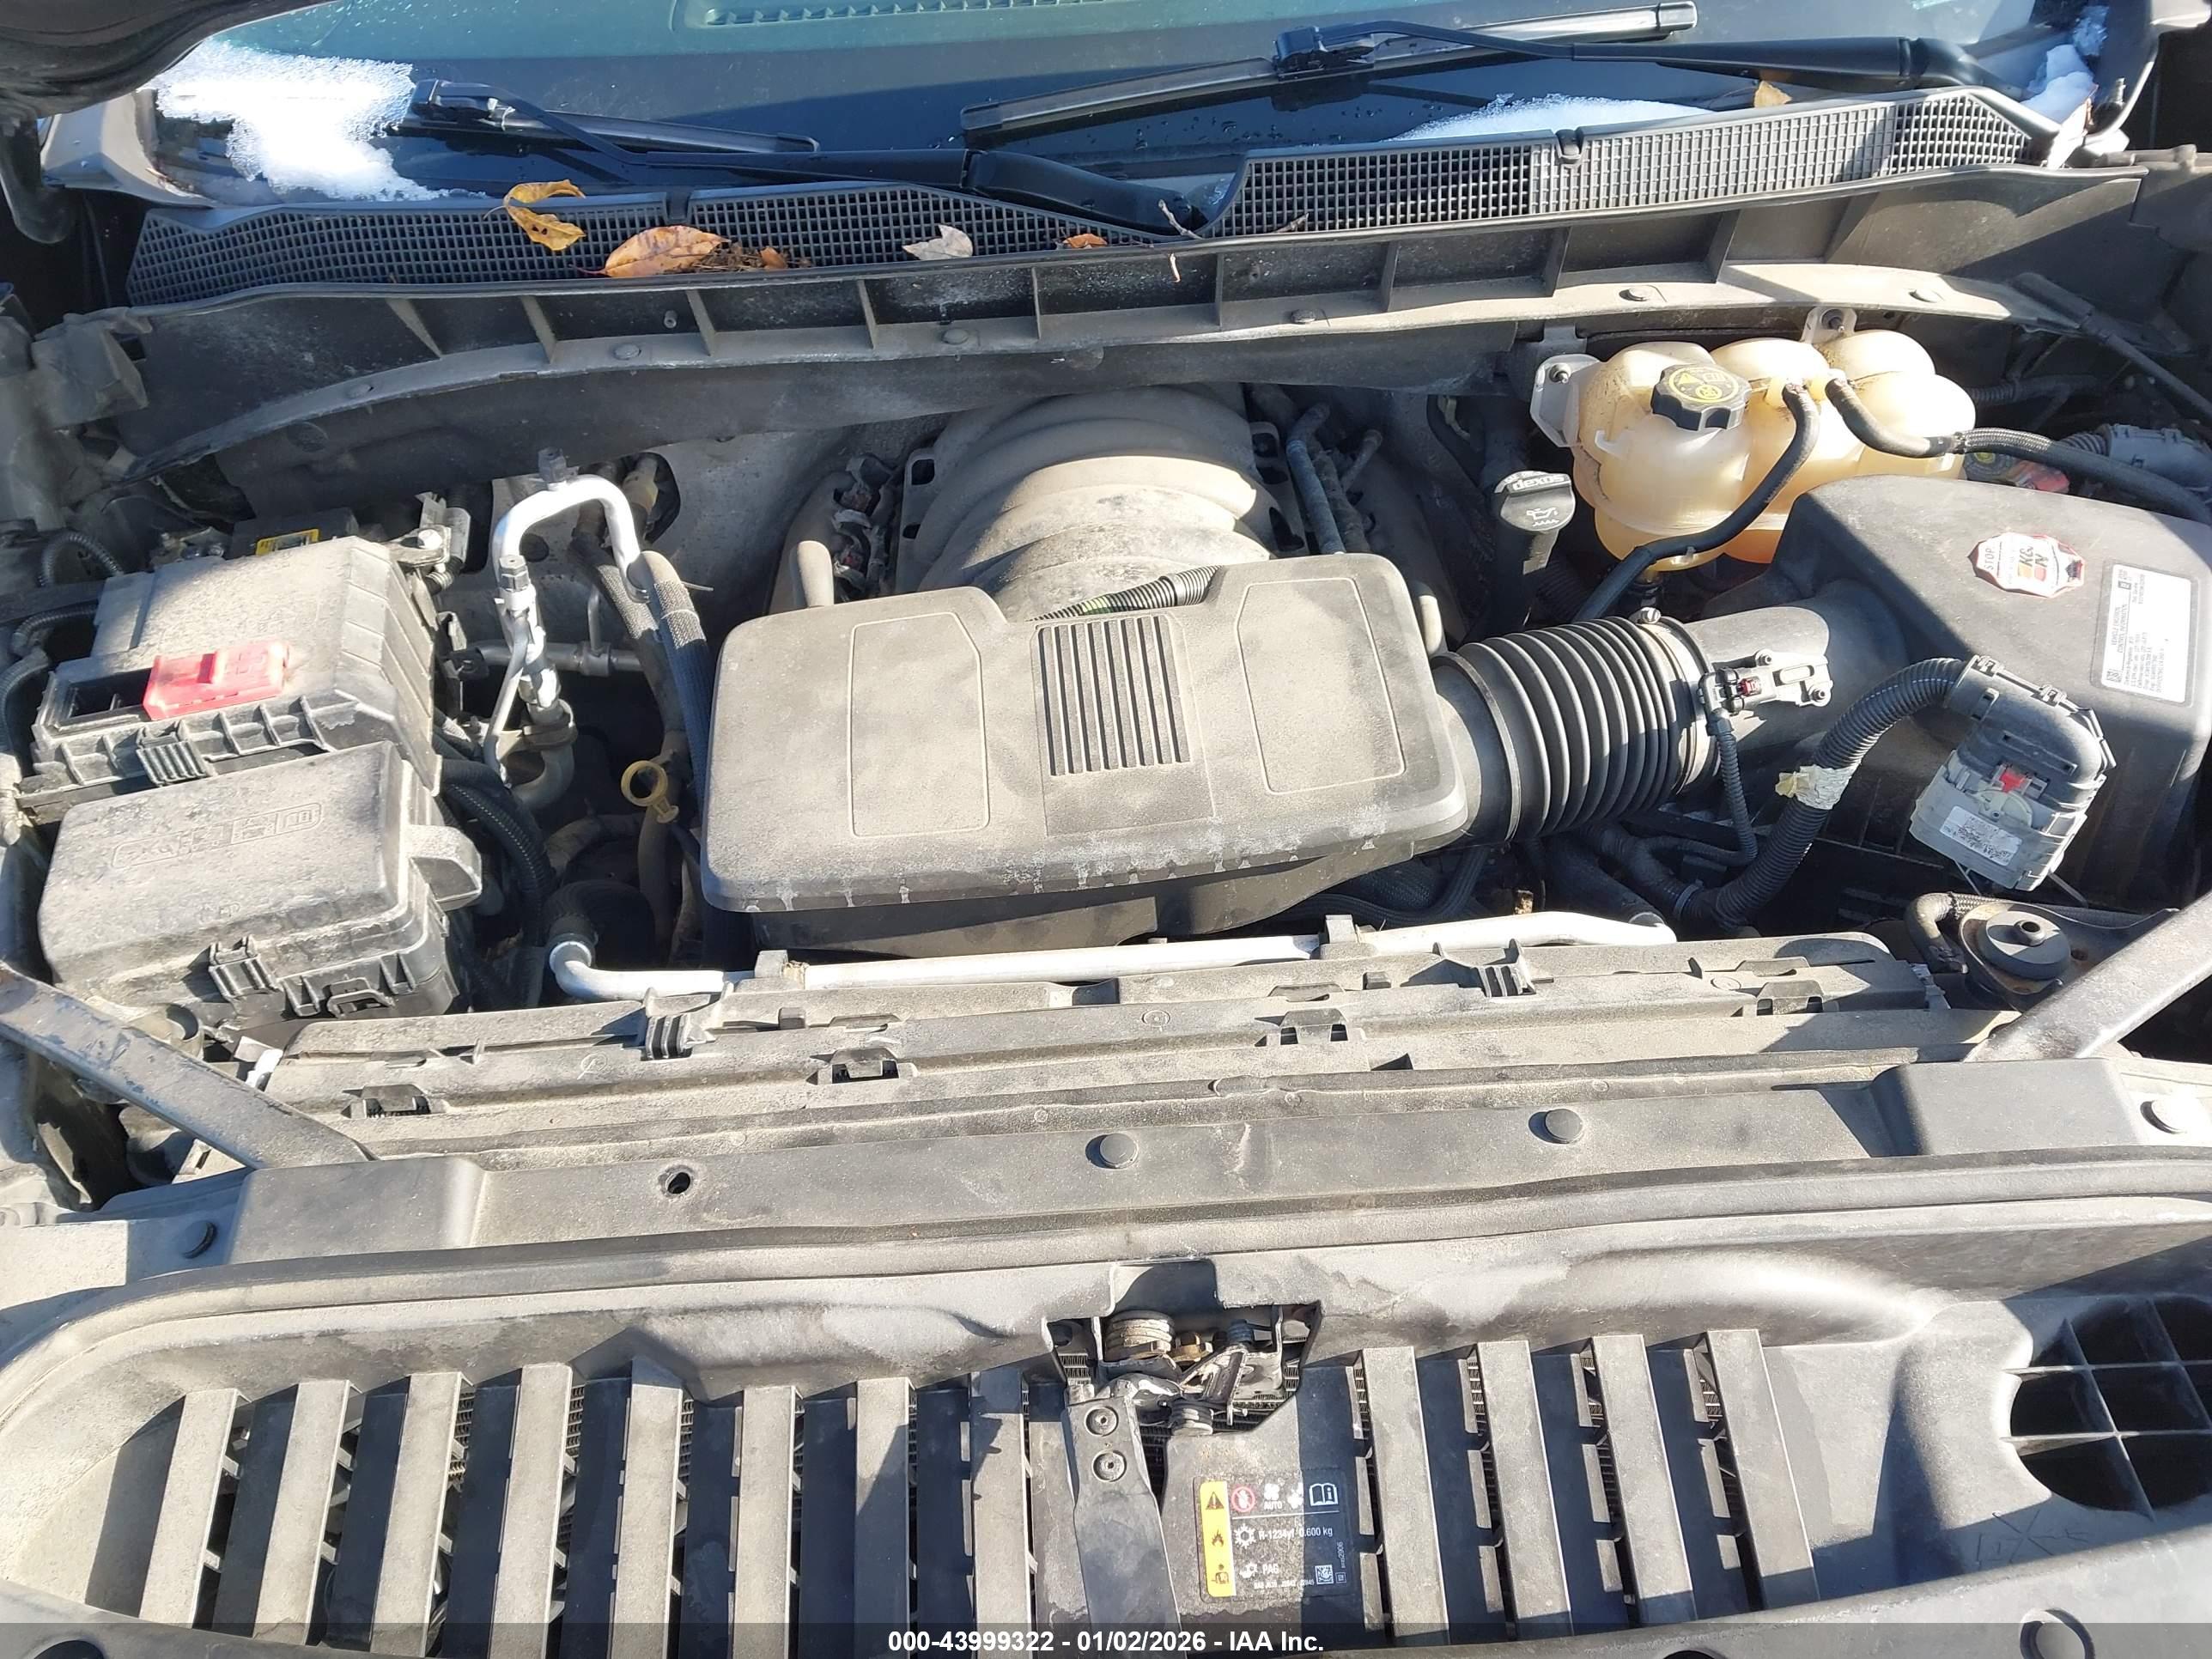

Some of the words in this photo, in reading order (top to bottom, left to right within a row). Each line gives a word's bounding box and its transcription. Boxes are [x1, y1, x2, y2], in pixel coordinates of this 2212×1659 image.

[1512, 476, 1565, 490] dexos
[1984, 548, 1995, 570] STOP
[1264, 1501, 1283, 1510] AUTO
[1298, 1527, 1322, 1538] 0.600
[1322, 1528, 1333, 1538] kg
